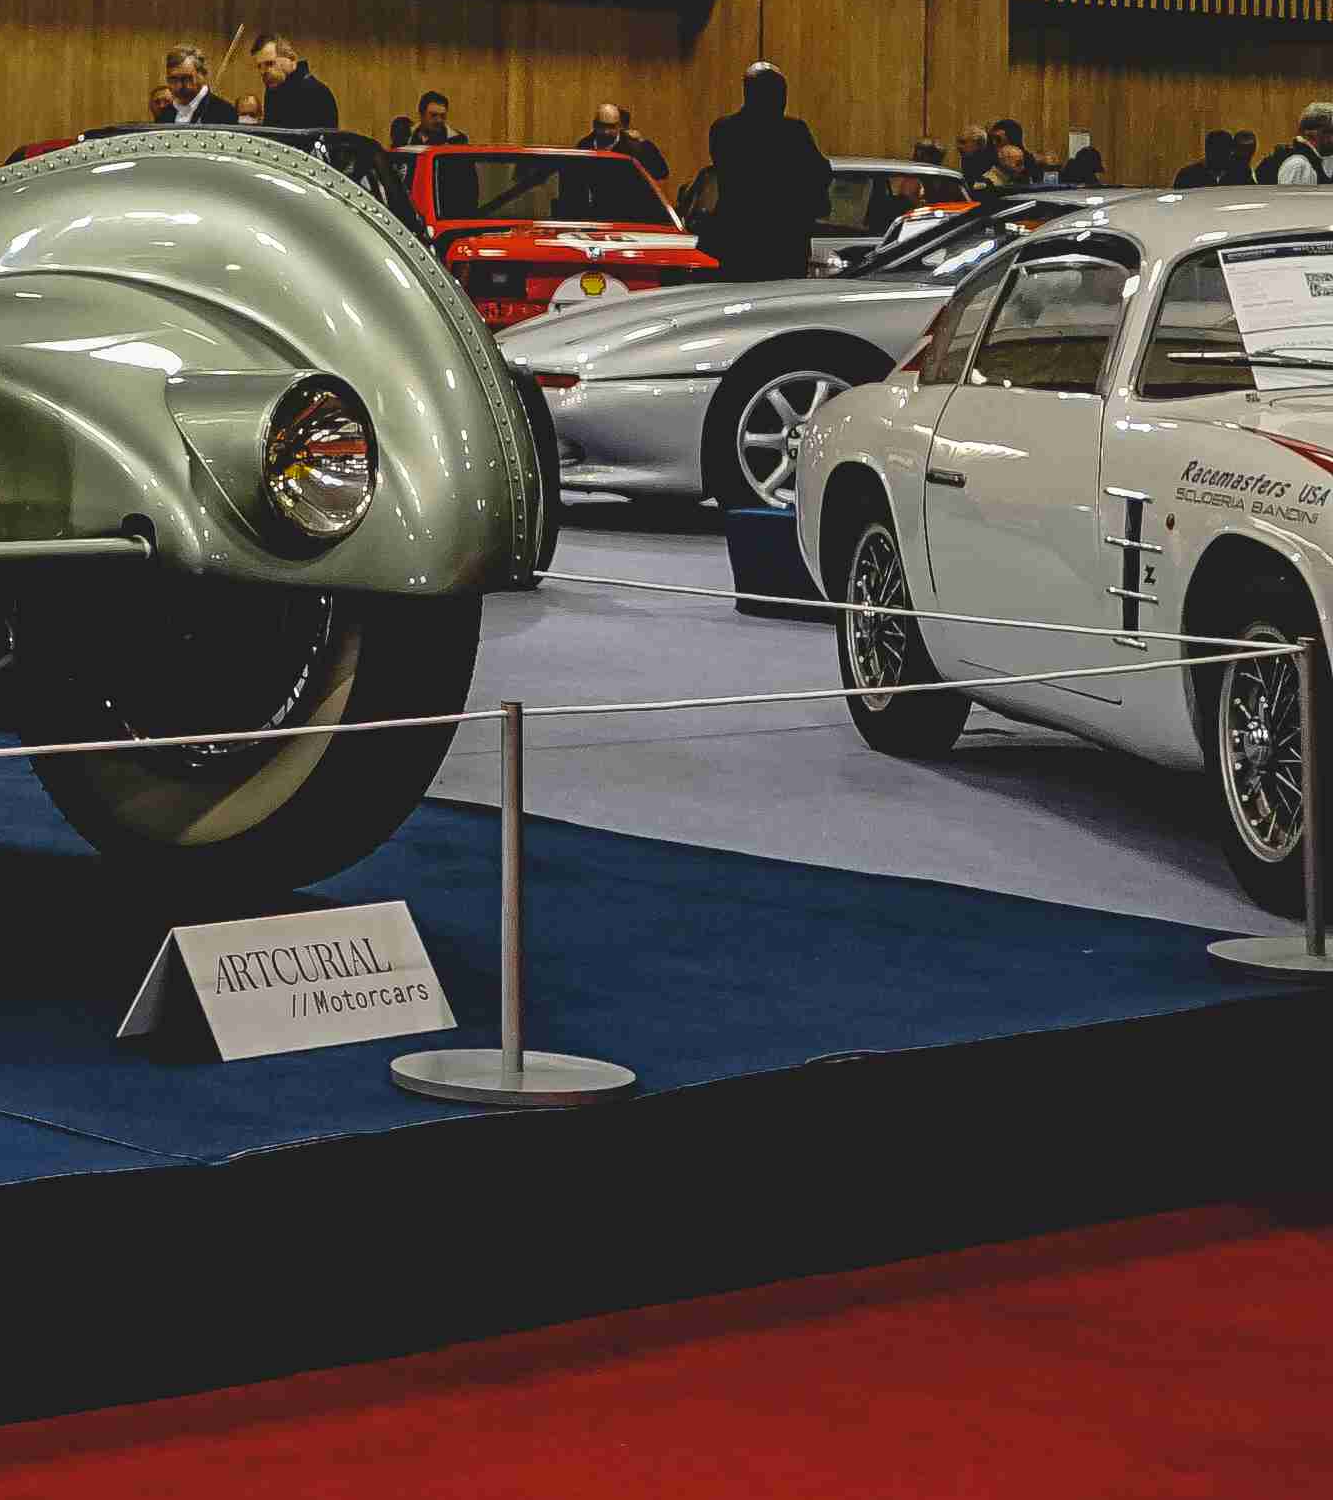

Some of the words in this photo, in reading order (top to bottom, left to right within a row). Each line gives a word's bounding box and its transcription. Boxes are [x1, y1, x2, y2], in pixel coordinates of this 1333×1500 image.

[1180, 460, 1292, 498] Racemasters
[1298, 482, 1332, 507] USA
[1251, 501, 1320, 525] BANDINI
[215, 936, 393, 995] ARTCURIAL
